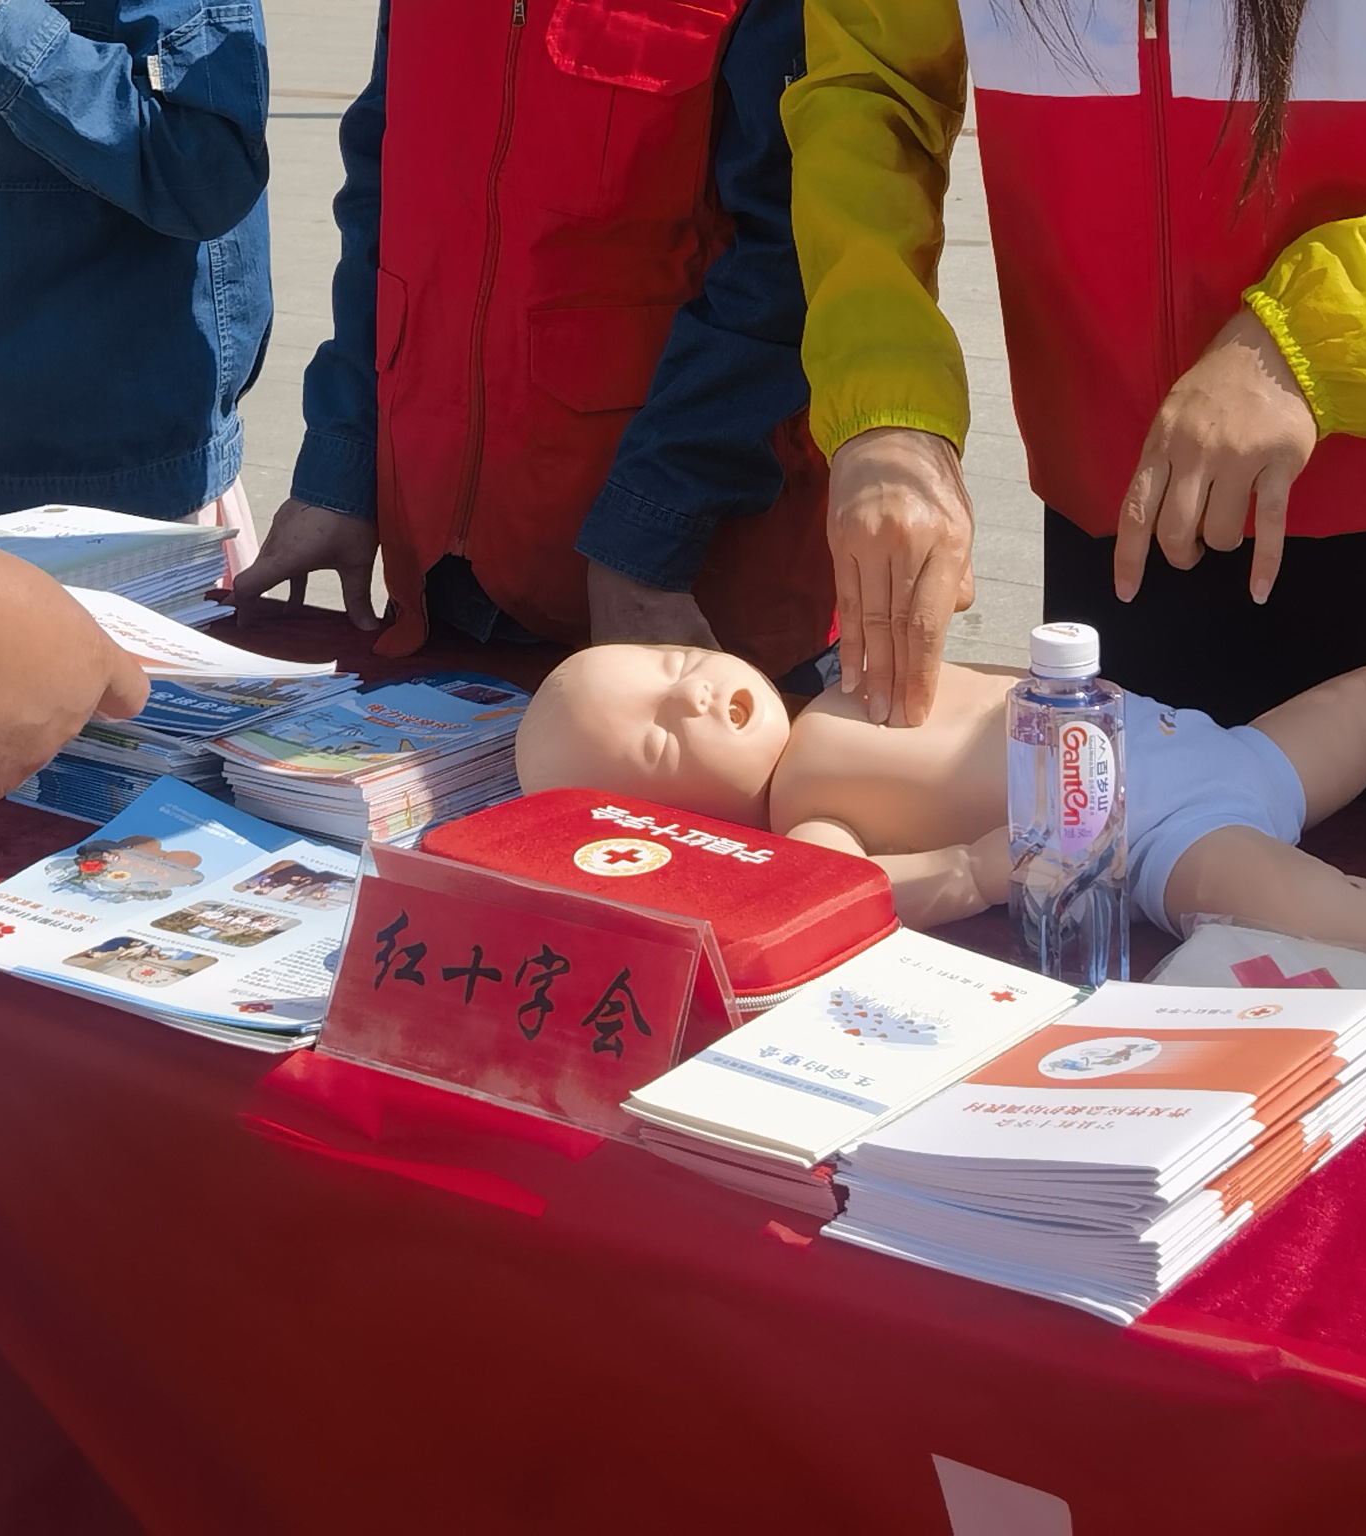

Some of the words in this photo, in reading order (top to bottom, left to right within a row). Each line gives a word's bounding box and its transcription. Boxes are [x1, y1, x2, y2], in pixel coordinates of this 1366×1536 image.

[1096, 759, 1109, 812] 百岁山
[590, 804, 775, 864] 宁县红十字会
[373, 910, 652, 1059] 红十字会
